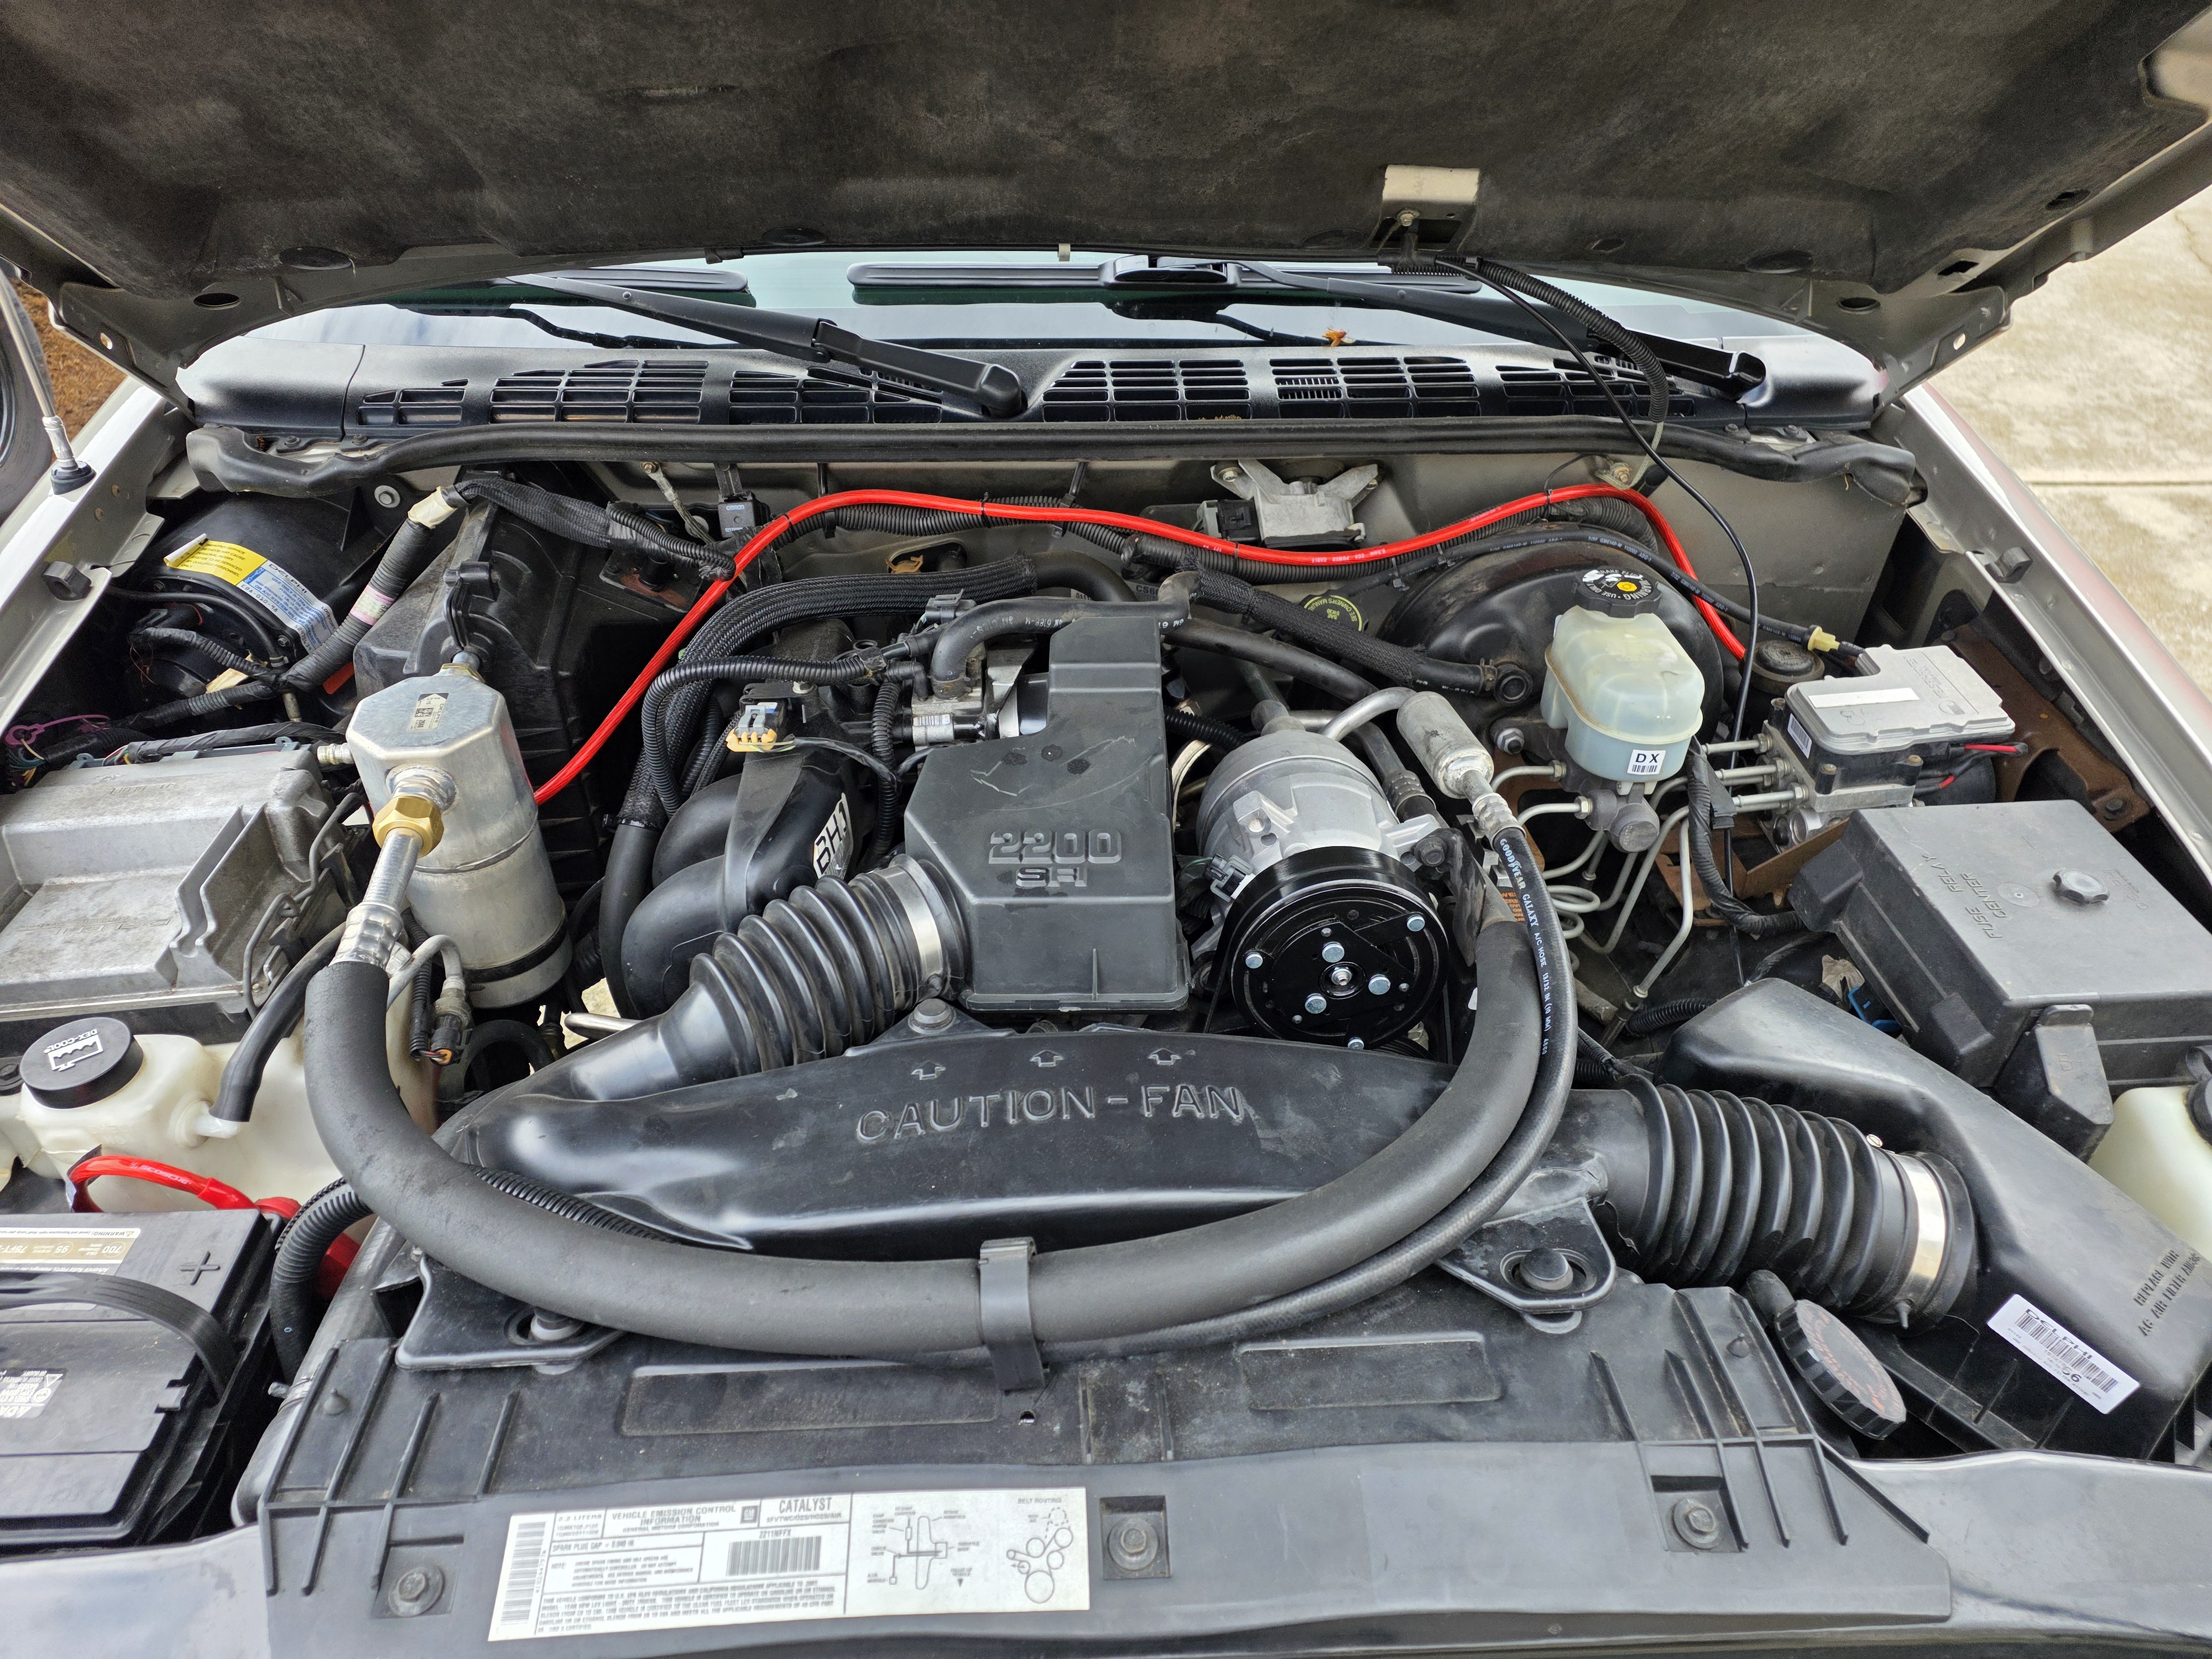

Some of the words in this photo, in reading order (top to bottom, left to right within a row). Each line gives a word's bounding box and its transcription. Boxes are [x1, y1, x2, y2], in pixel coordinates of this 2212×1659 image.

[227, 546, 246, 555] SERVICE
[230, 552, 246, 561] CAUSE
[220, 560, 243, 571] SERVICED
[244, 567, 263, 584] NOTICE
[268, 563, 307, 594] DELPHI
[1586, 583, 1602, 593] ONLY
[1601, 591, 1617, 599] USE
[1623, 580, 1652, 600] WARNING
[262, 589, 270, 598] A/C
[270, 596, 288, 612] SYSTEM
[288, 611, 298, 621] WILL
[272, 577, 281, 585] USE
[281, 583, 293, 594] ONLY
[305, 606, 327, 630] REFRIGERANT
[1308, 598, 1328, 611] MANUAL
[1328, 598, 1352, 612] OWNER'S
[1349, 611, 1358, 622] SEE
[435, 703, 444, 723] DELPHI
[989, 829, 1121, 864] 2200
[1500, 838, 1526, 890] GOODYEAR
[1922, 854, 1964, 892] RELAY
[1961, 873, 2007, 918] CENTER
[1522, 894, 1539, 927] GALAXY
[1965, 906, 2003, 938] FUSE
[1534, 932, 1542, 946] A/C
[1538, 946, 1547, 968] HOSE
[1542, 972, 1550, 992] 13/32
[1544, 993, 1551, 1002] IN
[139, 1164, 190, 1185] SCOSCHE
[55, 1245, 70, 1254] 95
[101, 1245, 122, 1254] 700
[2133, 1269, 2164, 1306] REPLACE
[2161, 1250, 2179, 1269] WITH
[2138, 1319, 2153, 1336] AC
[2151, 1301, 2167, 1319] AIR
[2162, 1274, 2186, 1301] FILTER
[2025, 1308, 2093, 1359] DELPHI
[612, 1511, 647, 1520] VEHICLE
[650, 1507, 693, 1518] EMISSION
[696, 1505, 735, 1515] CONTROL
[779, 1497, 832, 1514] CATALYST
[640, 1515, 701, 1526] INFORMATION
[743, 1509, 755, 1520] GM
[553, 1543, 572, 1552] SPARK
[573, 1542, 588, 1551] PLUG
